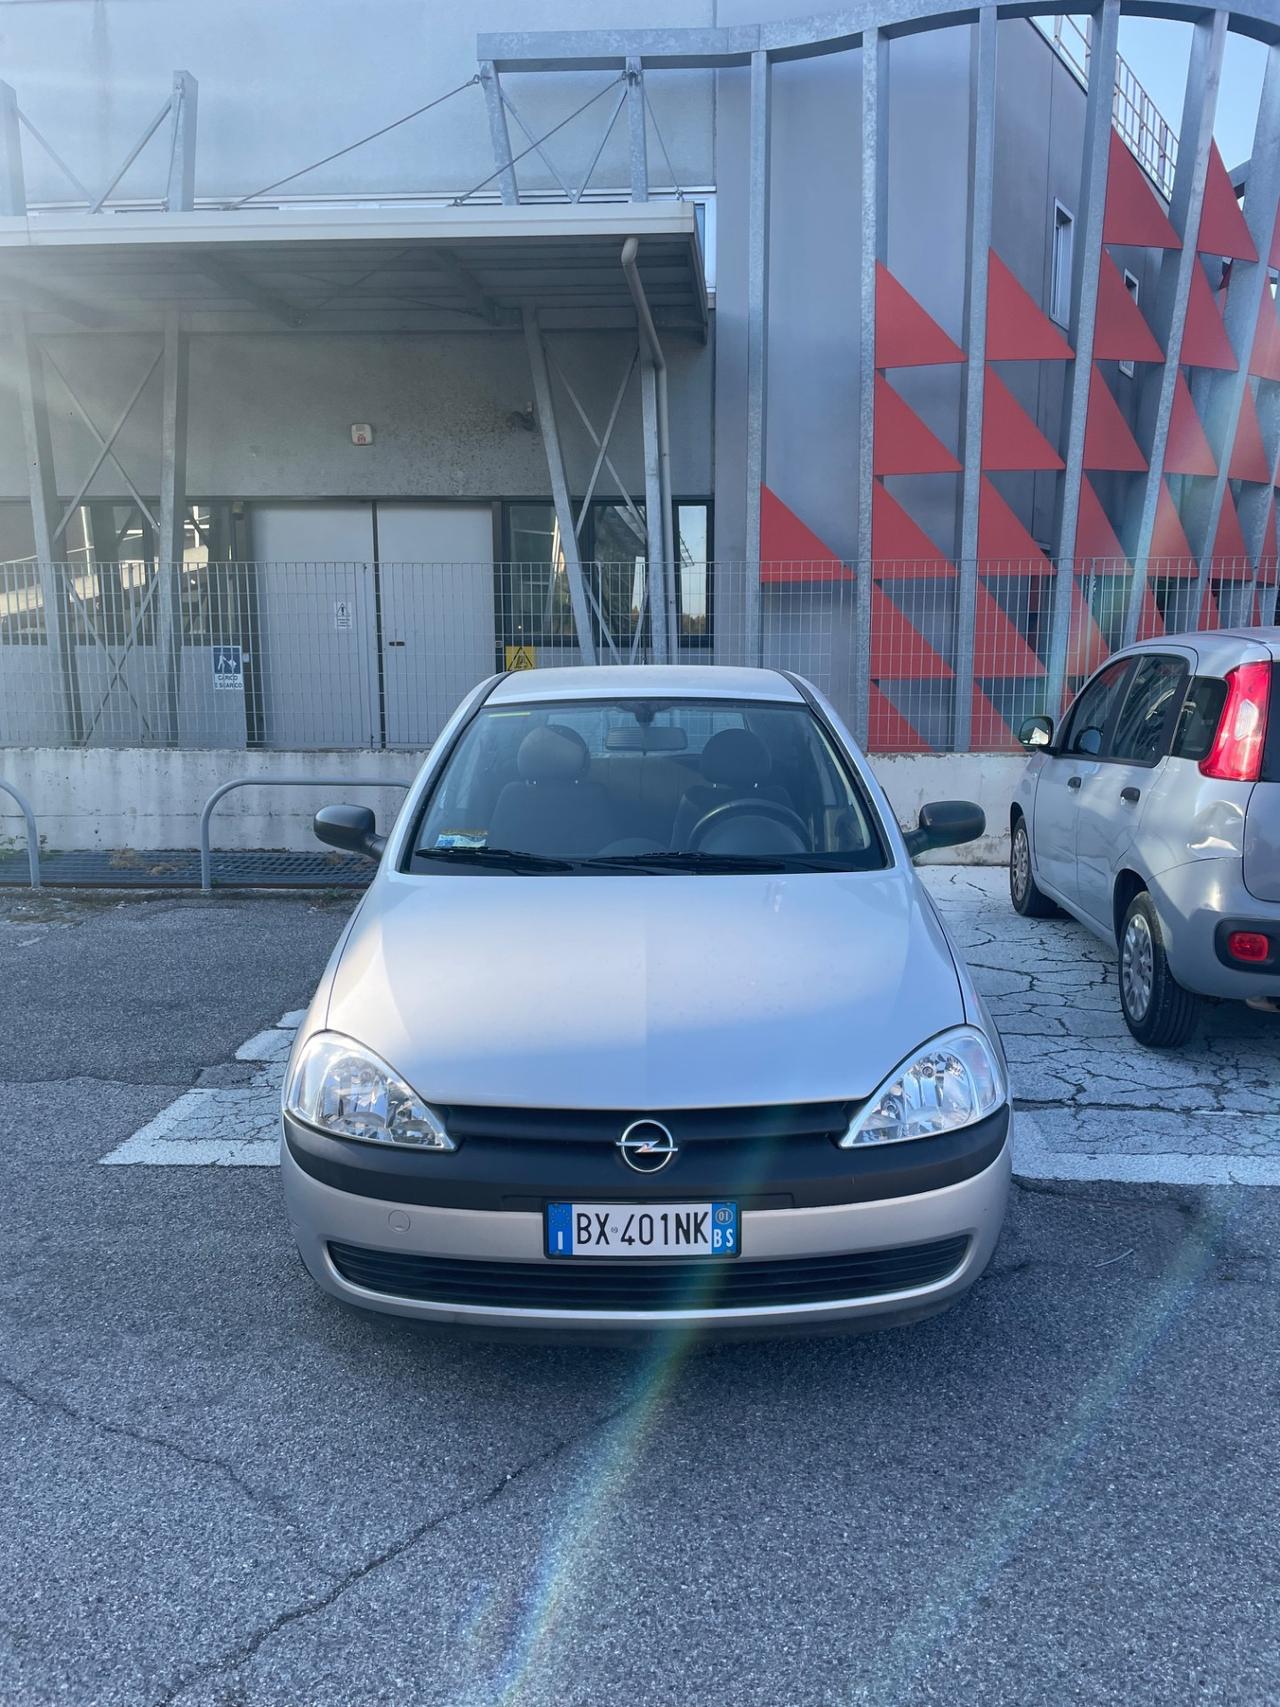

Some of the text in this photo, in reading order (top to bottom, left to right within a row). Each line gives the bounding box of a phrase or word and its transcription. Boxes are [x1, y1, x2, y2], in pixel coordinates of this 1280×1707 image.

[557, 1212, 734, 1250] I BX 401NK BS
